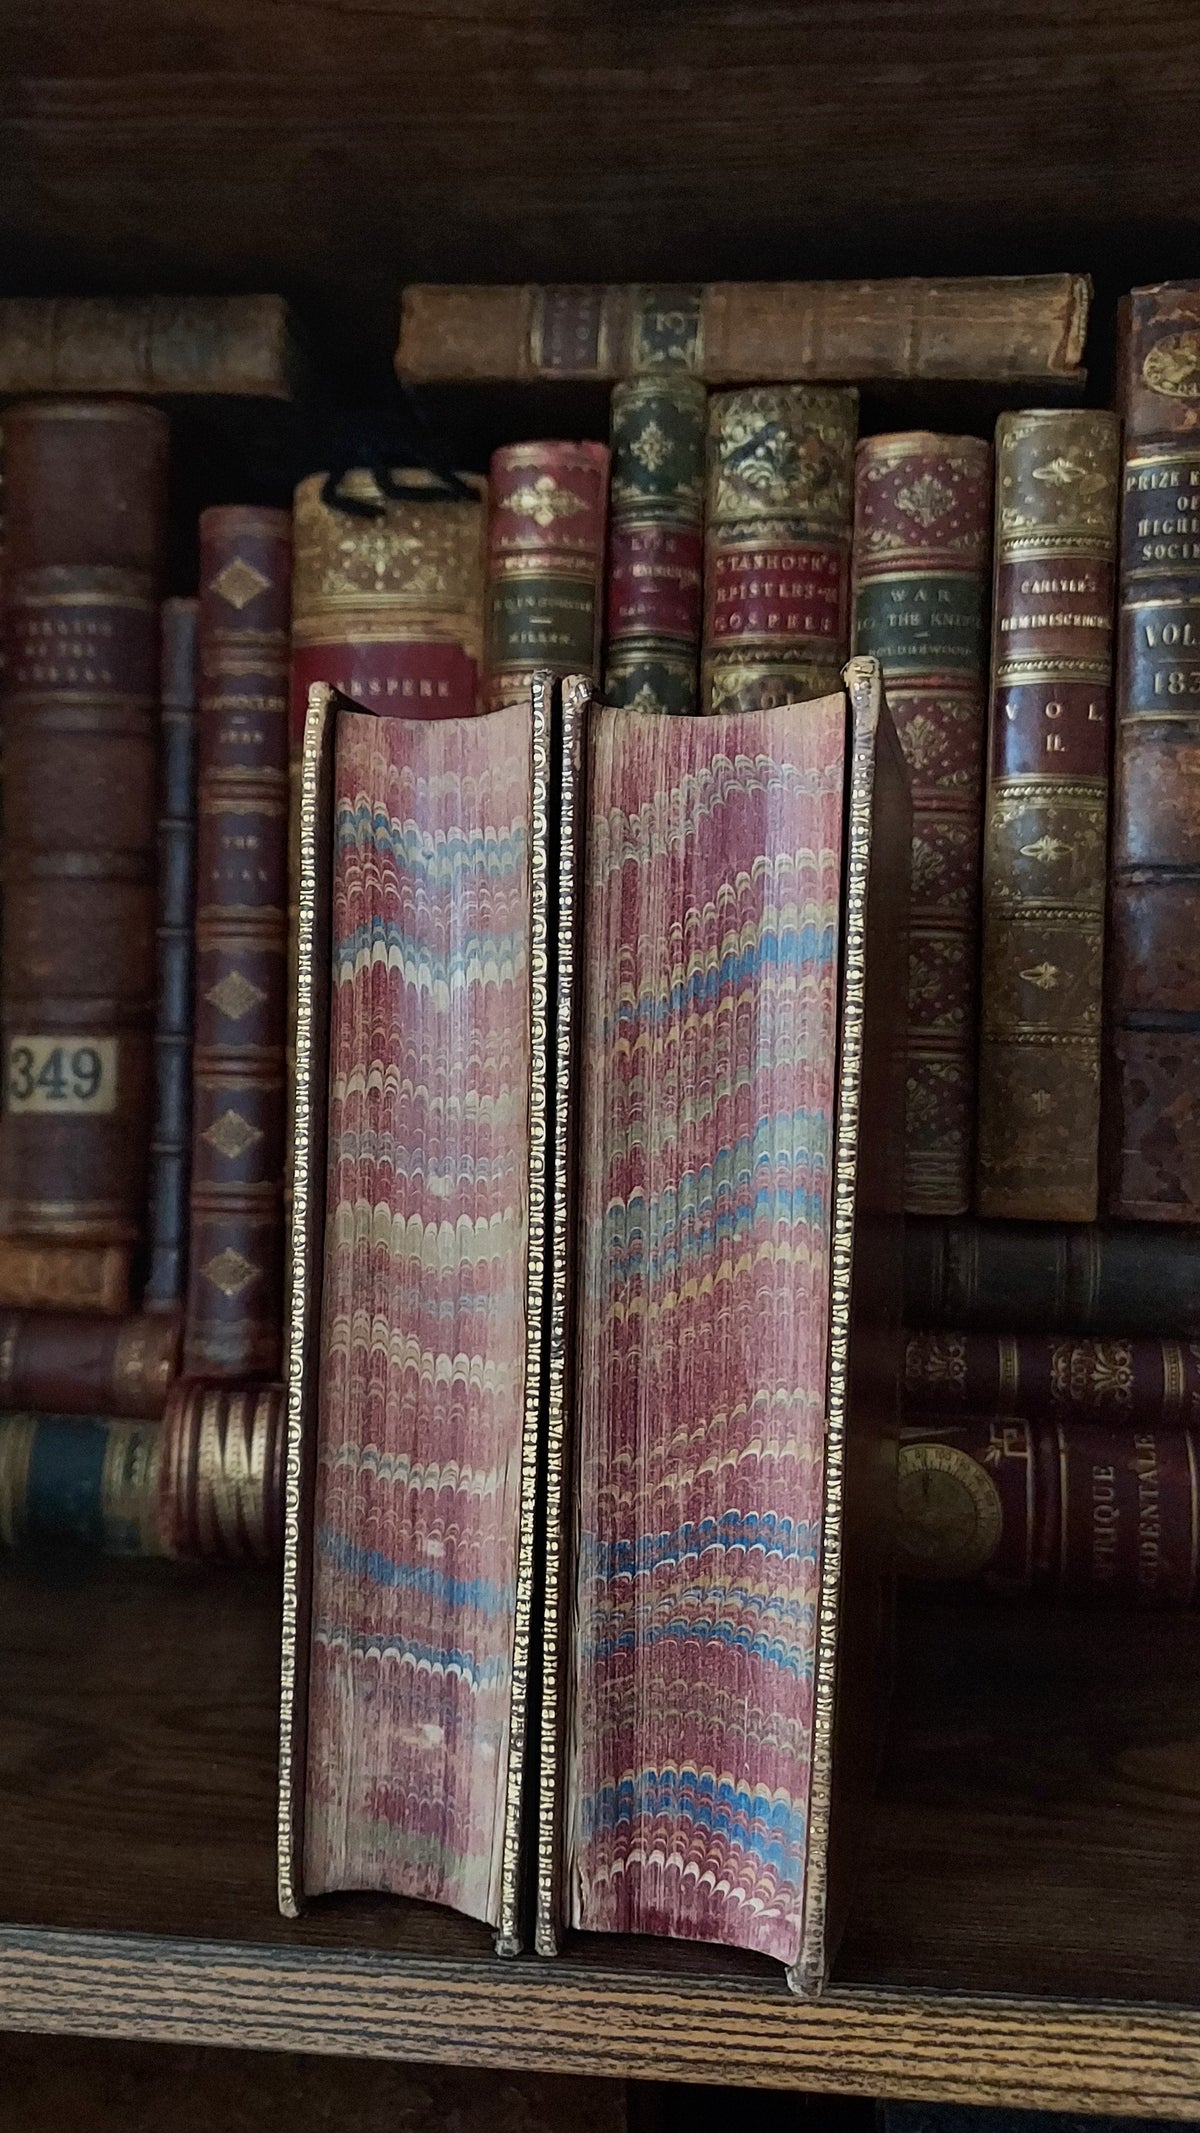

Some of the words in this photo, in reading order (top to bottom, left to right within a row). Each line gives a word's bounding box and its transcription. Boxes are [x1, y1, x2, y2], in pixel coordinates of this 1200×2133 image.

[1127, 470, 1180, 492] PRIZE
[1020, 572, 1097, 594] CARLYLE'S
[890, 588, 951, 602] WAR
[888, 611, 920, 627] THE
[10, 1046, 103, 1100] 349
